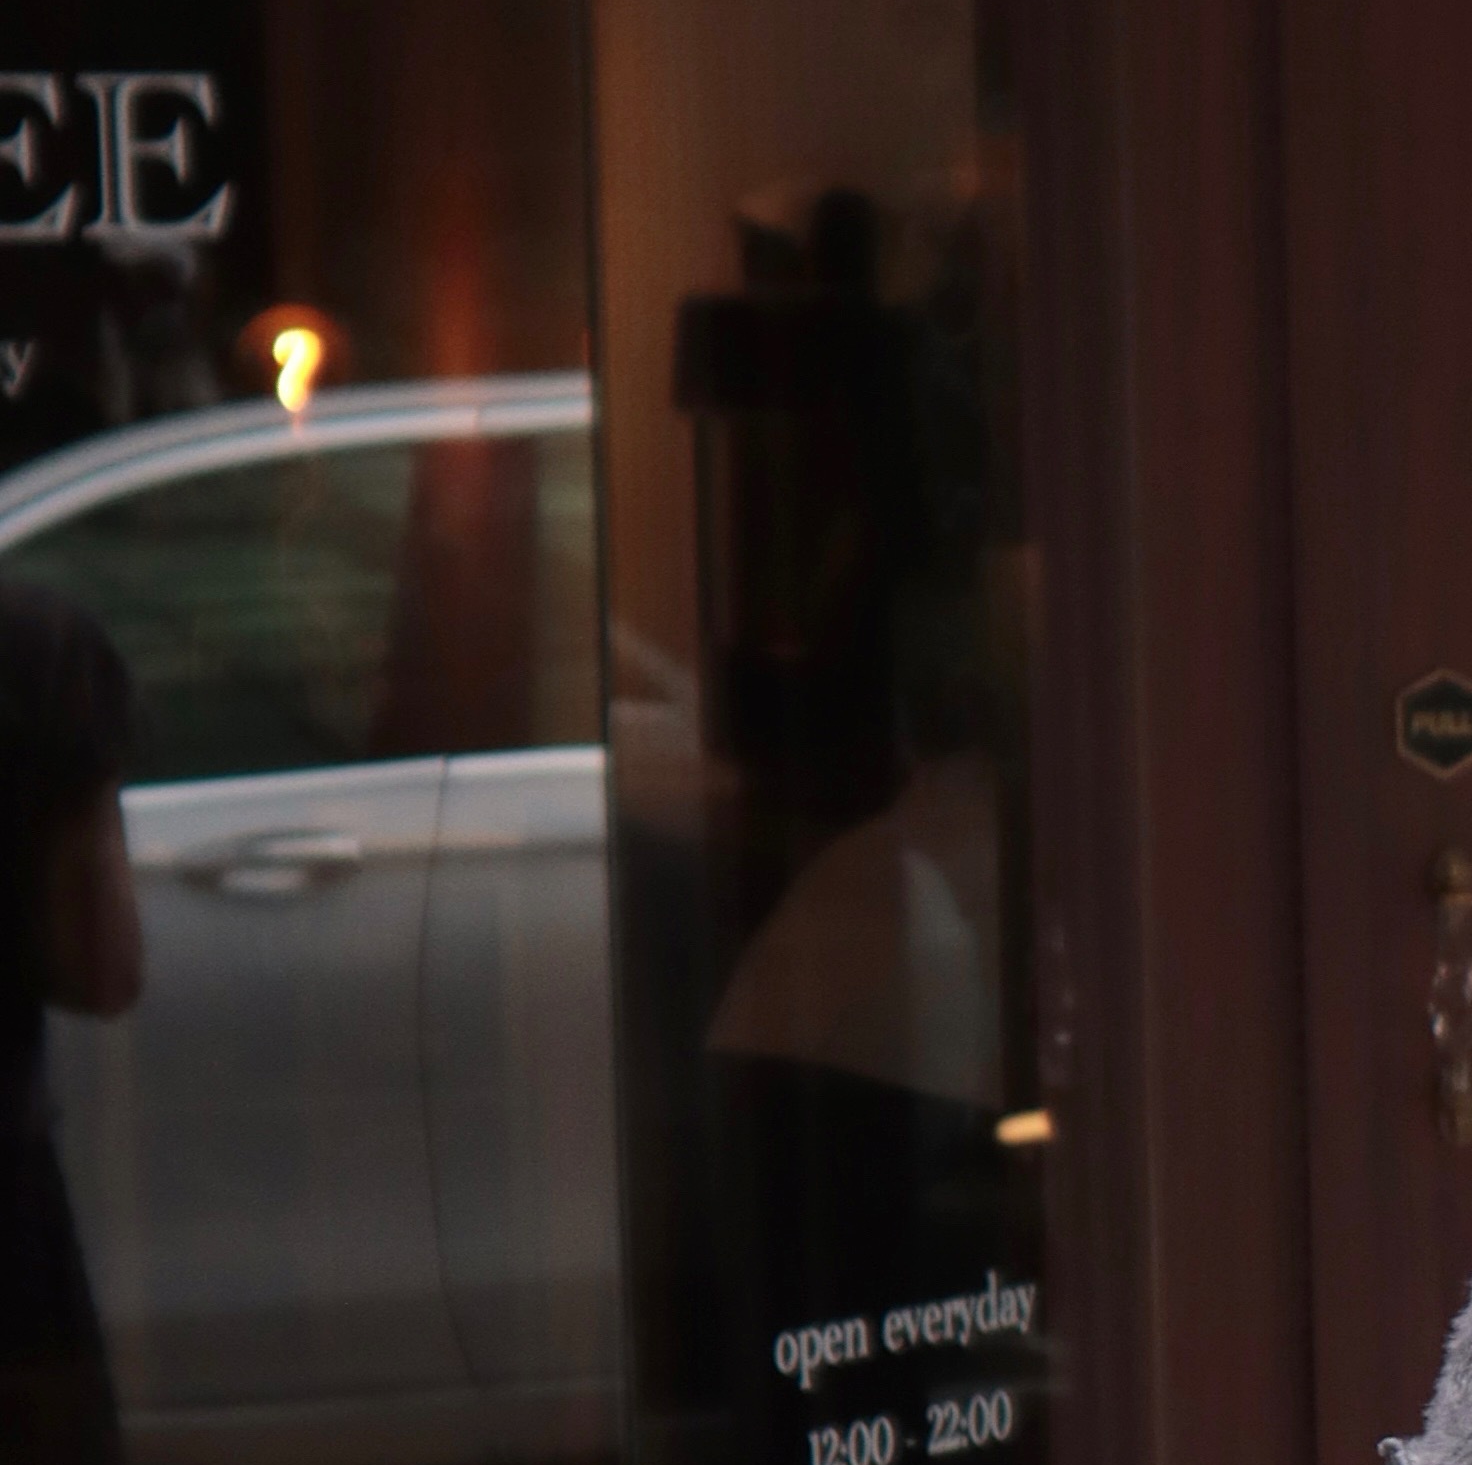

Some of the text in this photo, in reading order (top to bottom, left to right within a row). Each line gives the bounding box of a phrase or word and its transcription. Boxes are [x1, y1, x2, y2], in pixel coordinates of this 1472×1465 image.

[773, 1268, 1038, 1392] open everyday
[925, 1388, 1014, 1457] 22:00
